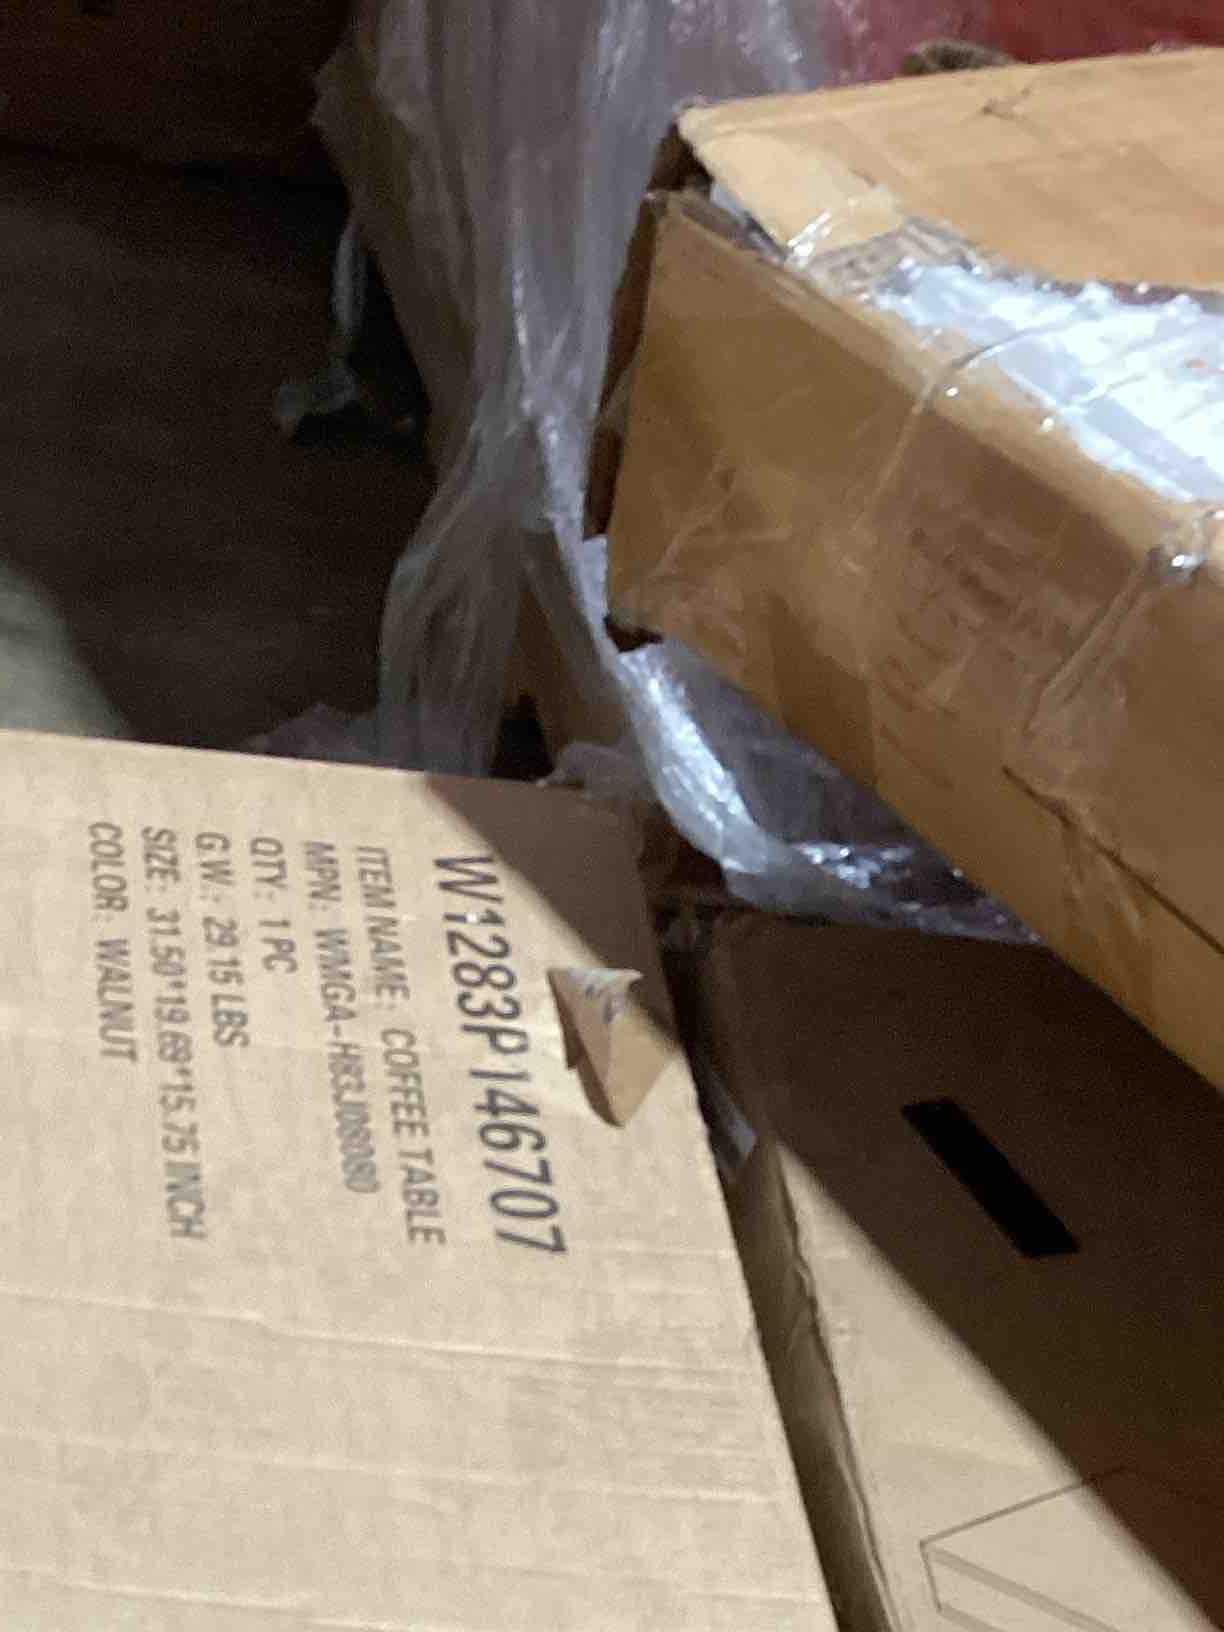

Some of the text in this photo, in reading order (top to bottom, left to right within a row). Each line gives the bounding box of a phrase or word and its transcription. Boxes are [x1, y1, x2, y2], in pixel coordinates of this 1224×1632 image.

[89, 821, 137, 1063] COLOR: WALNUT
[250, 836, 289, 902] QTY:
[303, 840, 344, 911] MPN:
[211, 993, 250, 1049] LBS
[261, 935, 297, 974] PC
[141, 826, 180, 894] SIZE:
[164, 1161, 207, 1241] INCH
[355, 846, 445, 1247] ITEM NAME: COFFEE TABLE
[433, 856, 567, 1255] W1283P146707
